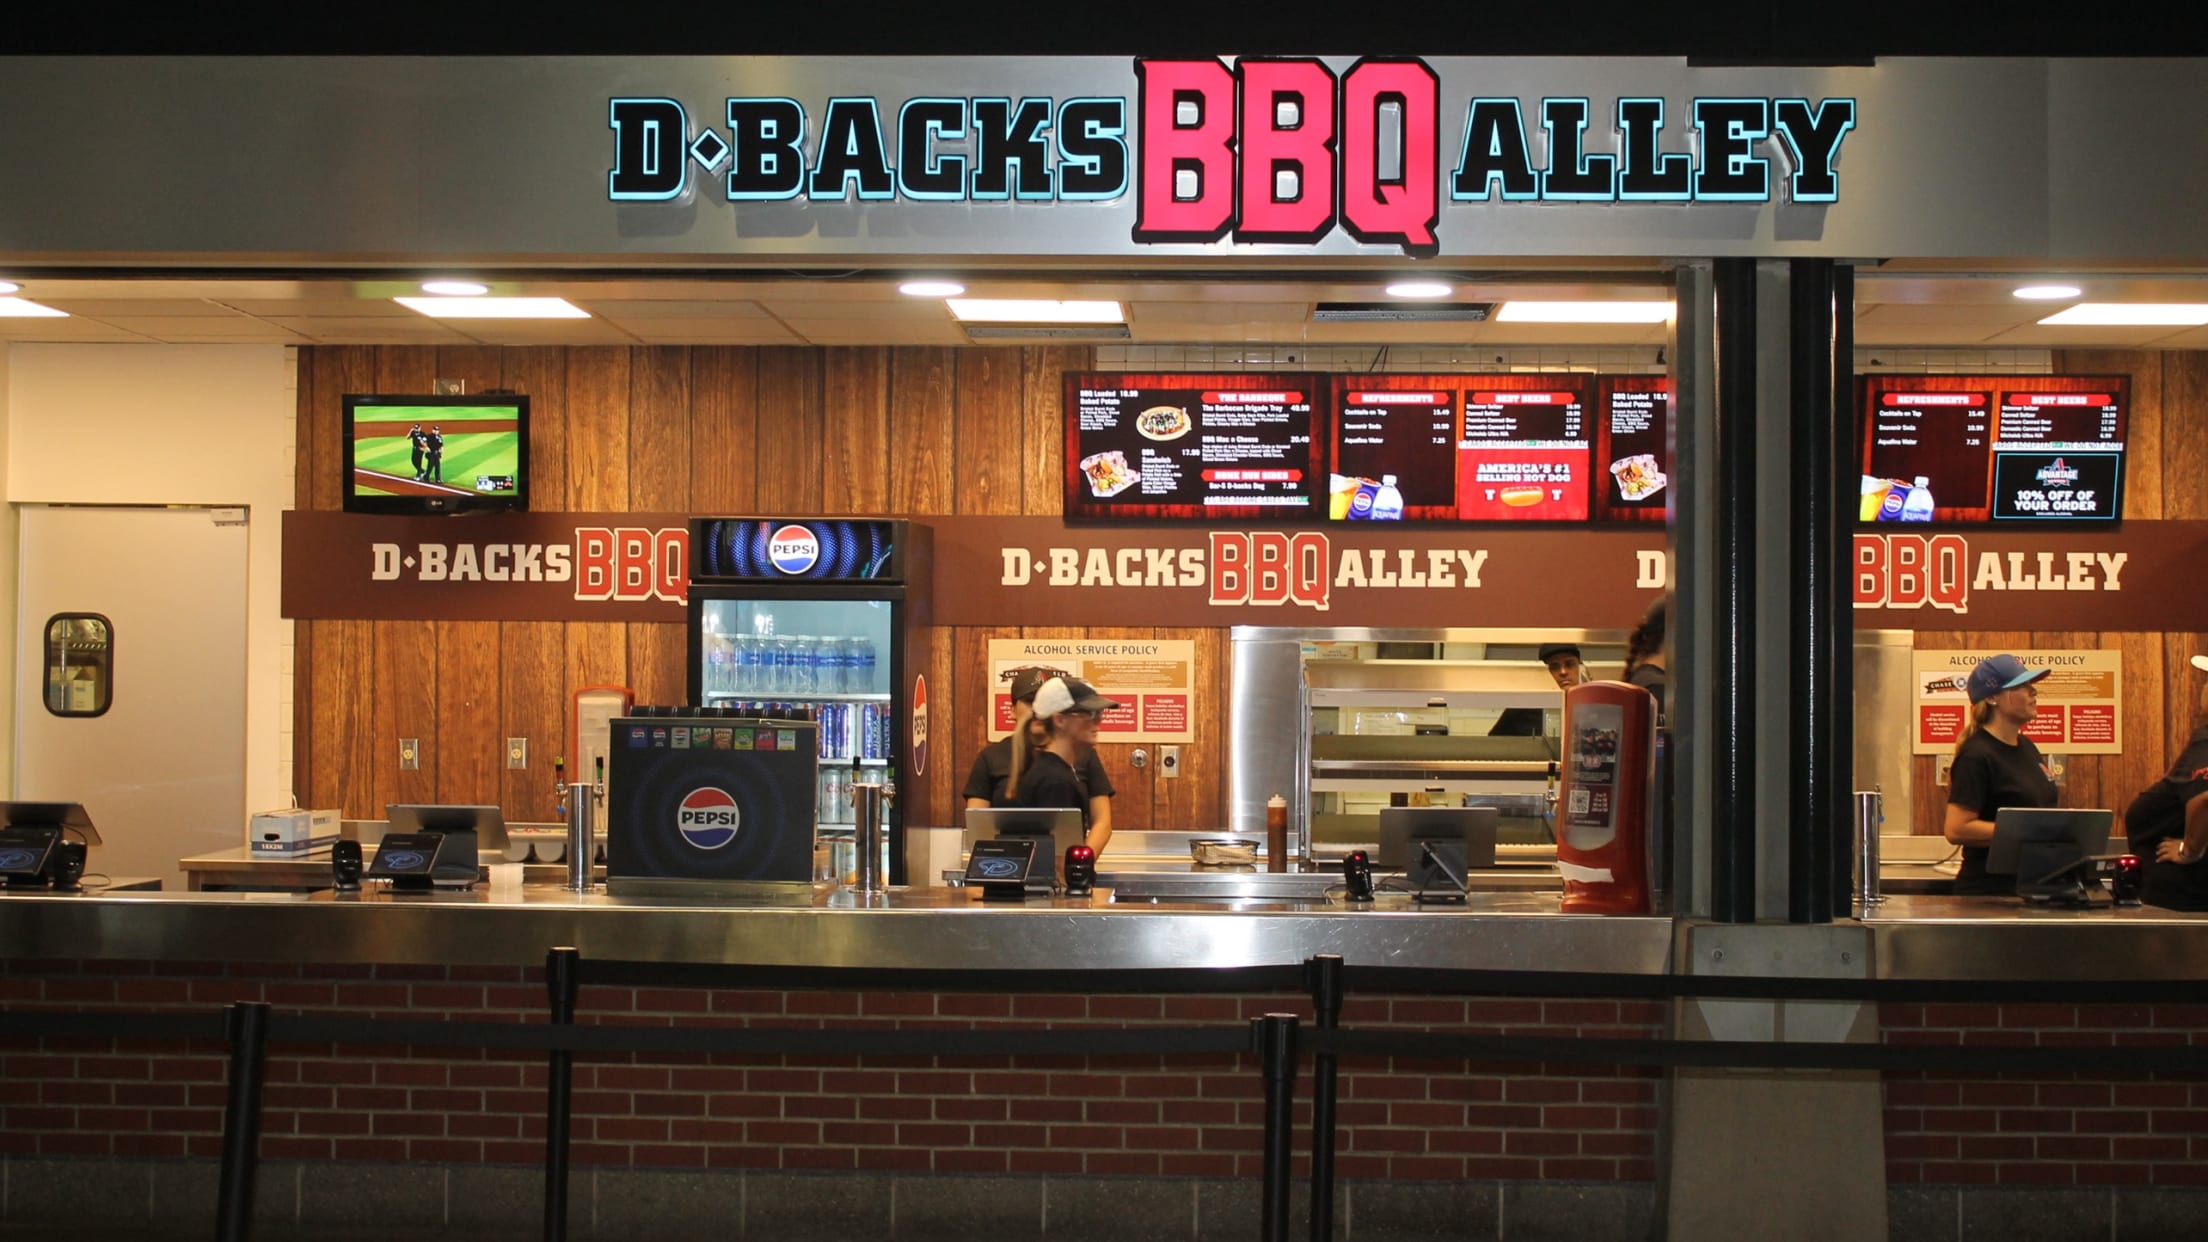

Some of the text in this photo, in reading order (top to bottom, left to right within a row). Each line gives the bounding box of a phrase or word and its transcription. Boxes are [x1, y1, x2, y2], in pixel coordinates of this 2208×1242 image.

[1133, 56, 1440, 258] BBQ
[1450, 97, 1856, 203] ALLEY
[1361, 393, 1434, 403] REFRESHMENTS
[1521, 394, 1551, 403] BEERS
[1897, 395, 1969, 404] REFRESHMENTS
[2057, 396, 2087, 404] BEERS
[1269, 405, 1283, 413] Tray
[1477, 463, 1570, 473] AMERICA'S #1
[1476, 474, 1571, 482] SELLING HOT DOG
[2036, 469, 2079, 480] ADVANTAGE
[1253, 482, 1265, 491] Dog
[2017, 490, 2095, 500] 10% OFF OF
[2014, 500, 2096, 511] YOUR ORDER
[773, 544, 815, 555] PEPSI
[575, 527, 689, 605] BBQ
[1209, 531, 1329, 610] BBQ
[1335, 550, 1488, 588] ALLEY
[1853, 534, 2127, 614] BBQ ALLEY
[1024, 645, 1158, 655] ALCOHOL SERVICE POLICY
[1949, 656, 2085, 665] ALCOHO RVICE POLICY
[681, 811, 736, 825] PEPSI
